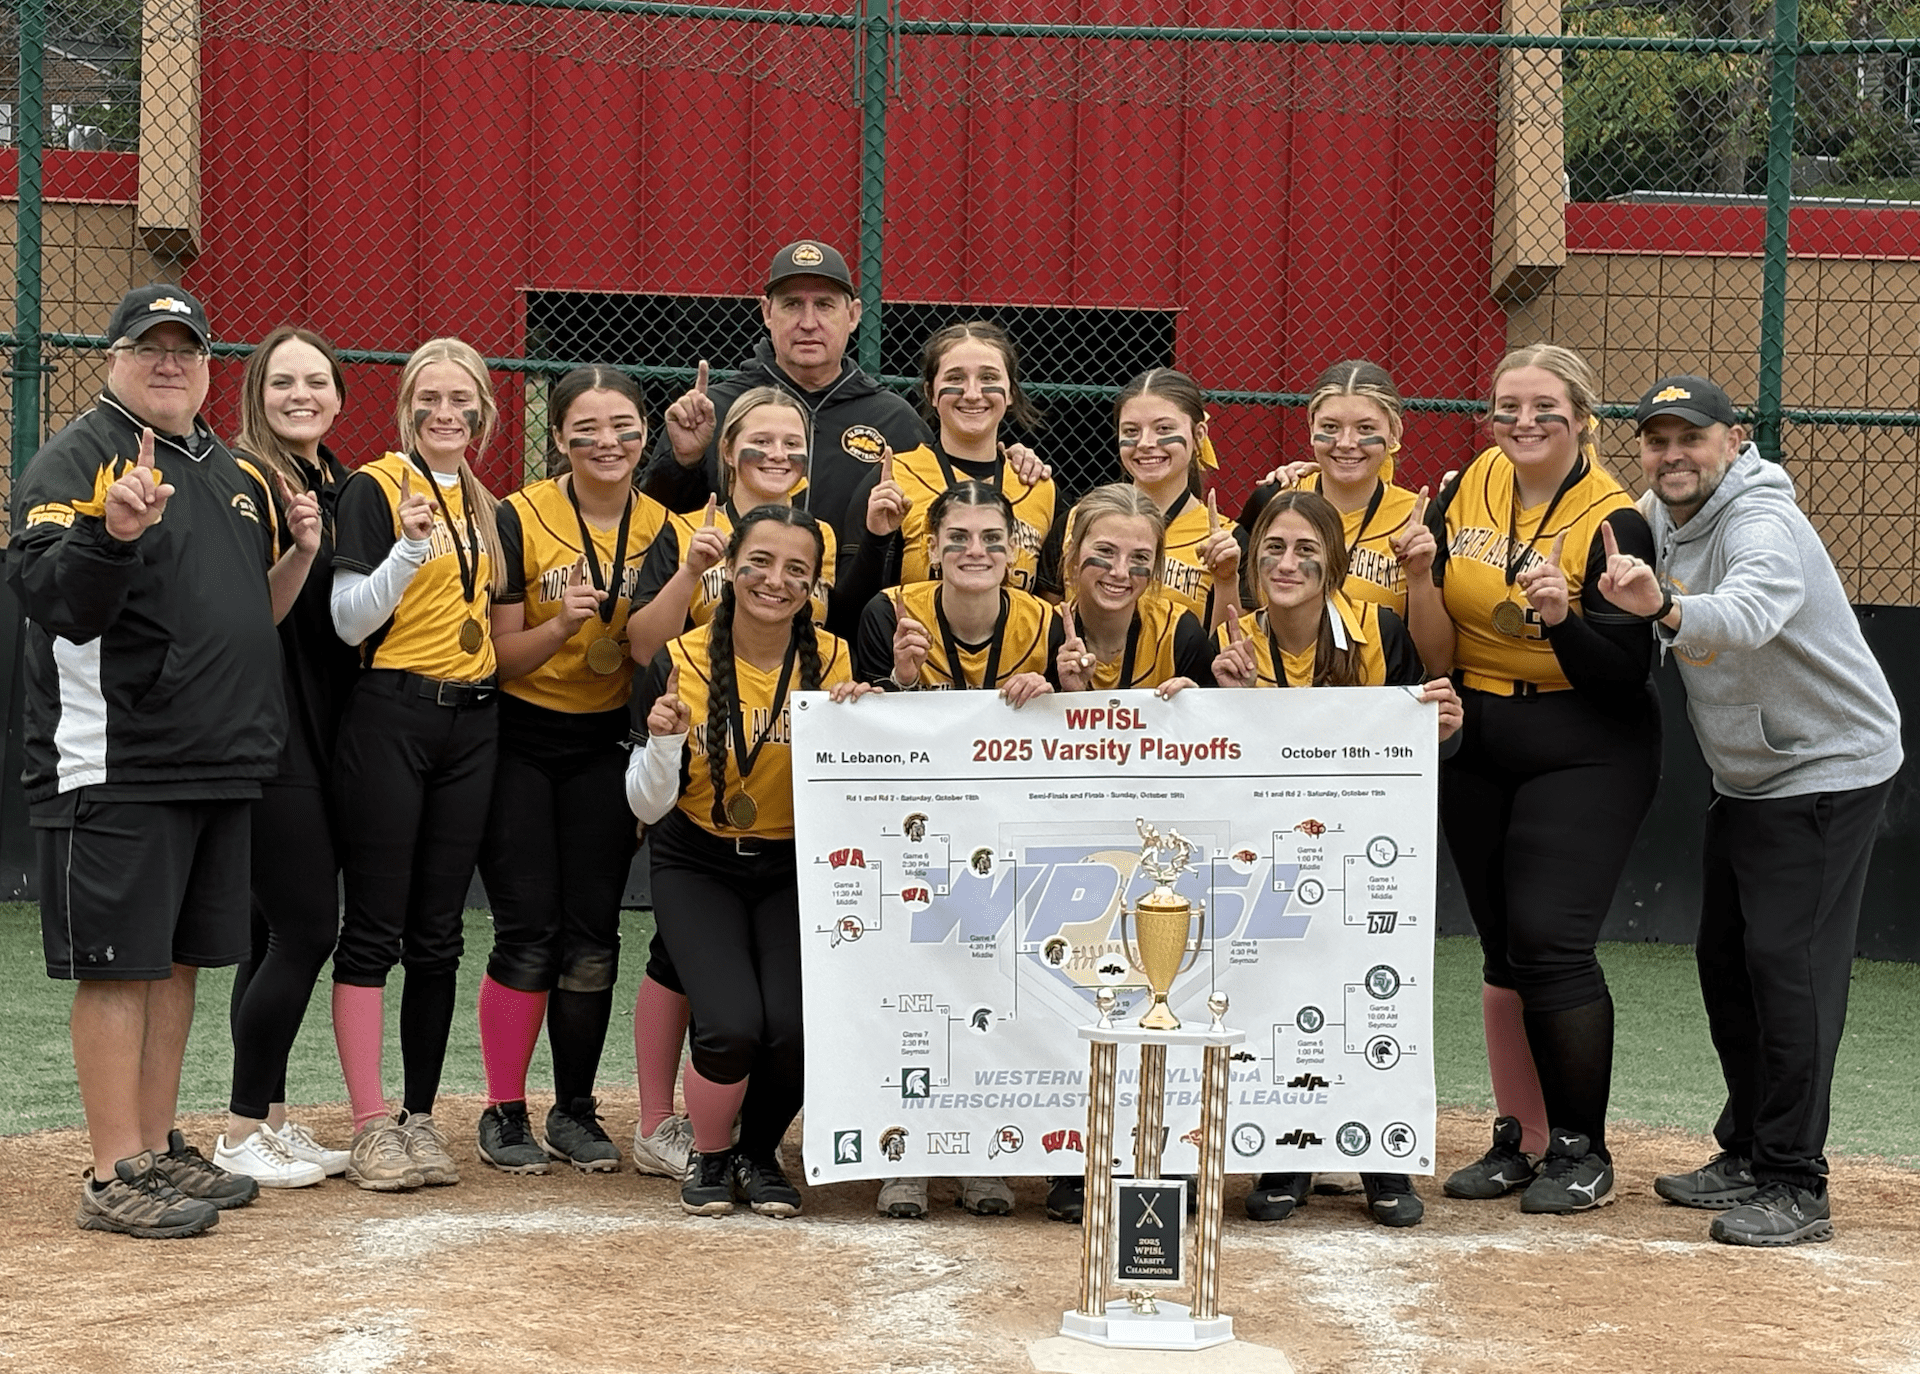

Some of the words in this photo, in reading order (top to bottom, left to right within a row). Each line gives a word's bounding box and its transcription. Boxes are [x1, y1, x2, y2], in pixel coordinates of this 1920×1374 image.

[1065, 708, 1147, 730] WPISL
[816, 751, 836, 764] Mt.
[841, 751, 906, 766] Lebanon,
[910, 751, 931, 763] PA
[972, 740, 1032, 762] 2025
[1041, 738, 1131, 766] Varsity
[1140, 737, 1241, 766] Playoffs
[1281, 746, 1337, 759] October
[1341, 746, 1371, 759] 18th
[1383, 746, 1413, 758] 19th
[1111, 792, 1138, 800] Sunday,
[829, 848, 866, 870] WA
[902, 887, 930, 904] WA
[899, 994, 933, 1012] NH
[975, 1070, 1083, 1087] WESTERN
[1239, 1089, 1328, 1105] LEAGUE
[928, 1132, 971, 1154] NH
[1042, 1130, 1085, 1154] WA
[1134, 1246, 1164, 1255] WPISL
